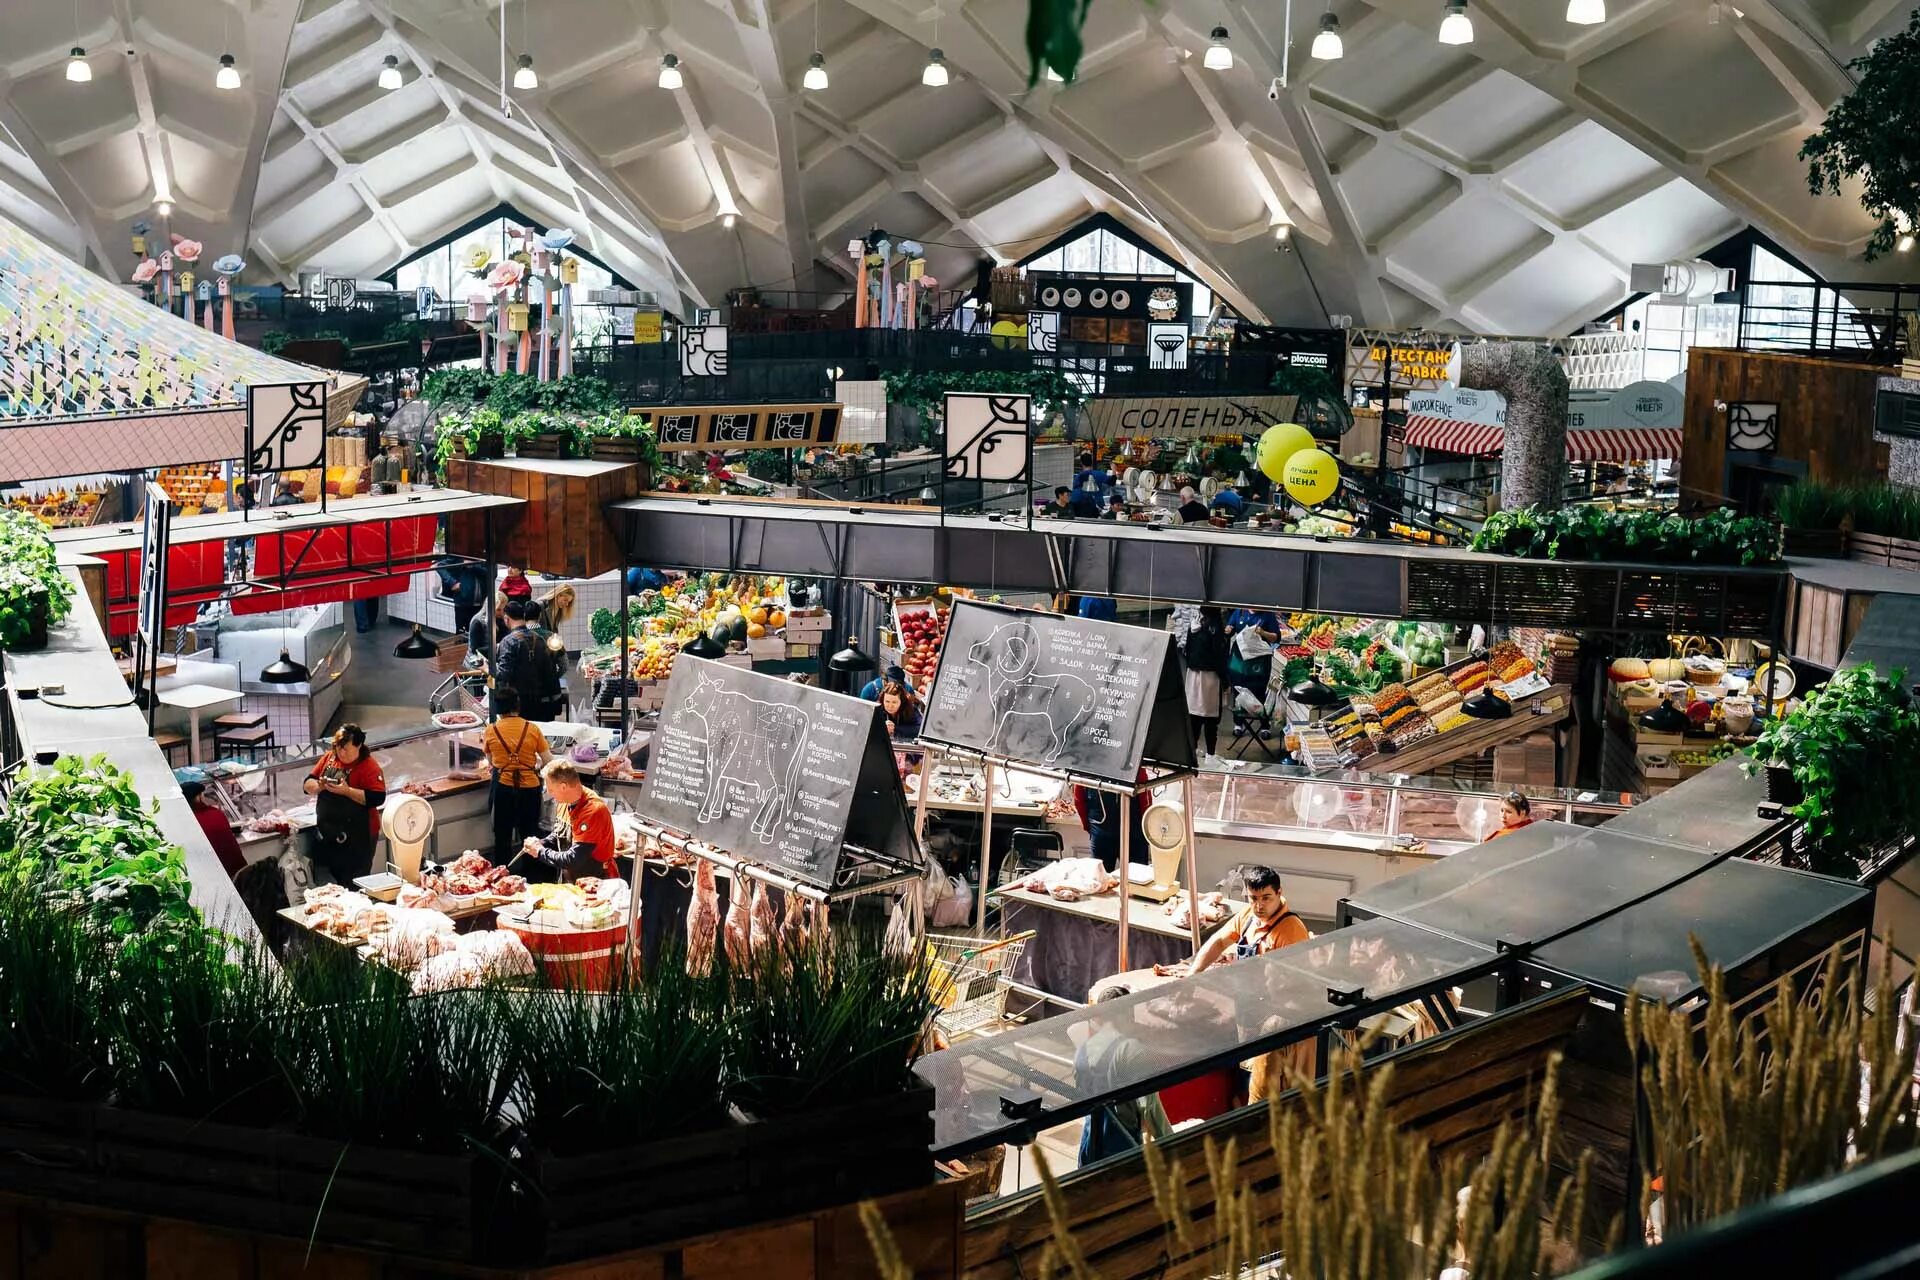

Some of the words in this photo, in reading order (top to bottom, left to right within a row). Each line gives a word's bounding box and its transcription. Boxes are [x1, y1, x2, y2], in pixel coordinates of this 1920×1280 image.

[1291, 354, 1327, 364] plov.com
[1401, 365, 1450, 381] ЛАВКА
[1411, 401, 1453, 418] МОРОЖЕНОЕ
[1291, 466, 1318, 475] ЛУЧШАЯ
[1290, 476, 1317, 487] ЦЕНА
[1095, 713, 1113, 722] ПЛОВ
[1089, 727, 1109, 738] РОГА
